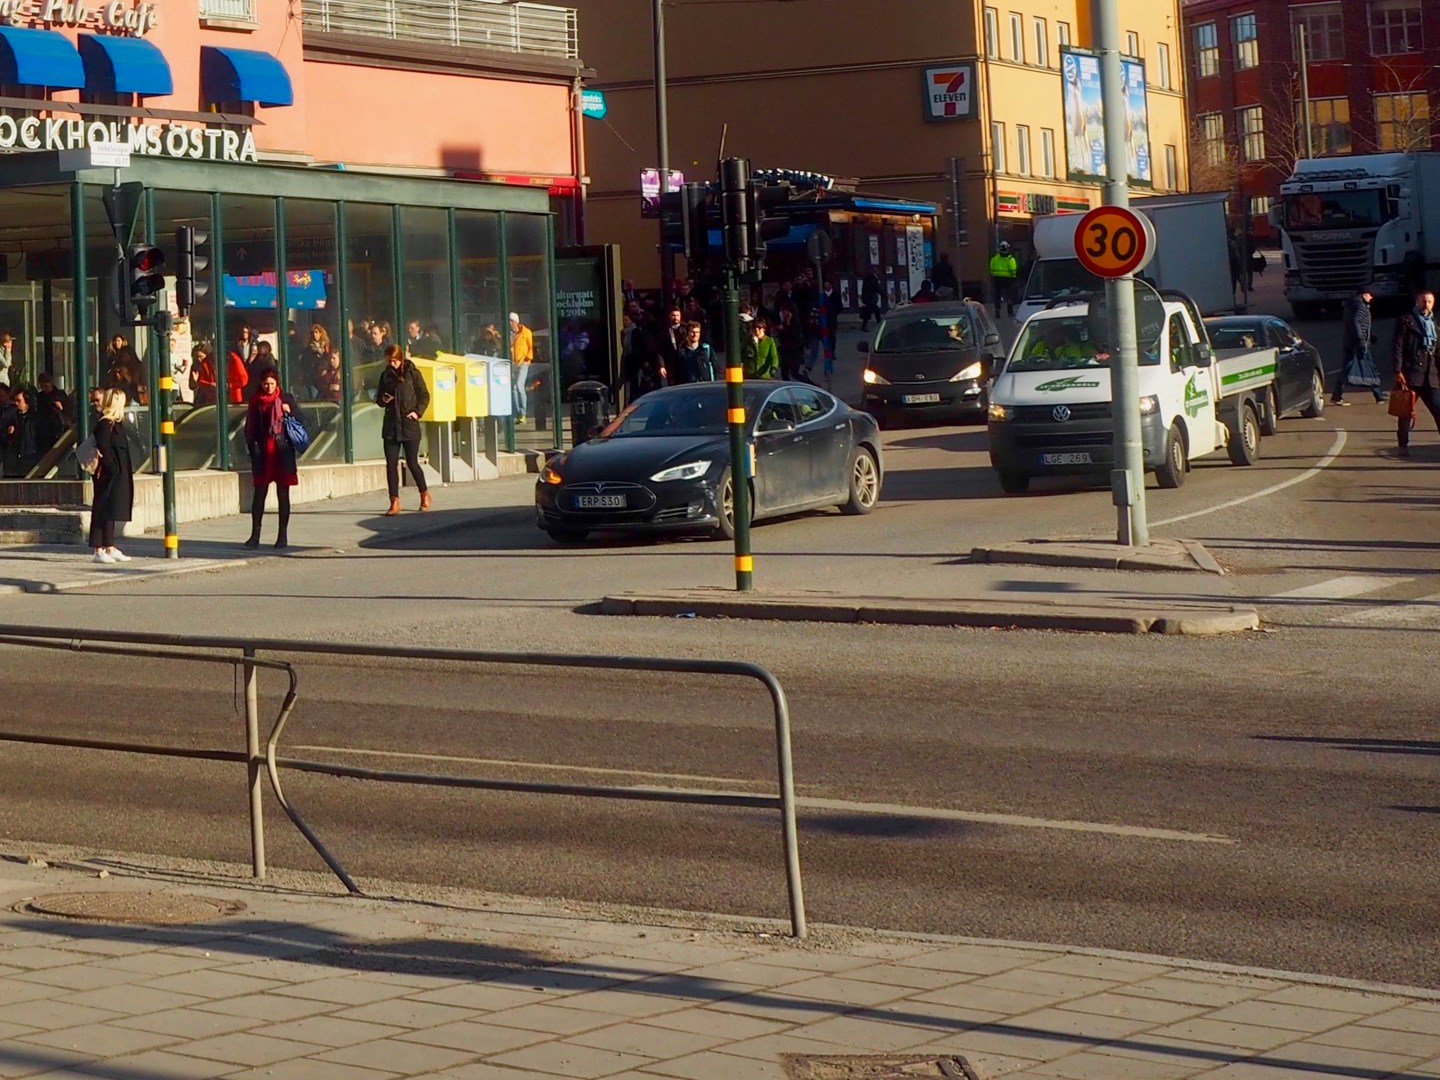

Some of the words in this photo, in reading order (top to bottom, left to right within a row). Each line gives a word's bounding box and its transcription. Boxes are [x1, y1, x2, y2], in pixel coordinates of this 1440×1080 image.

[103, 0, 158, 38] Café
[167, 125, 258, 163] ÖSTRA
[1085, 223, 1137, 261] 30
[1044, 454, 1062, 464] LGE
[1069, 453, 1088, 463] 269
[581, 496, 599, 507] ERP
[601, 495, 620, 506] 530
